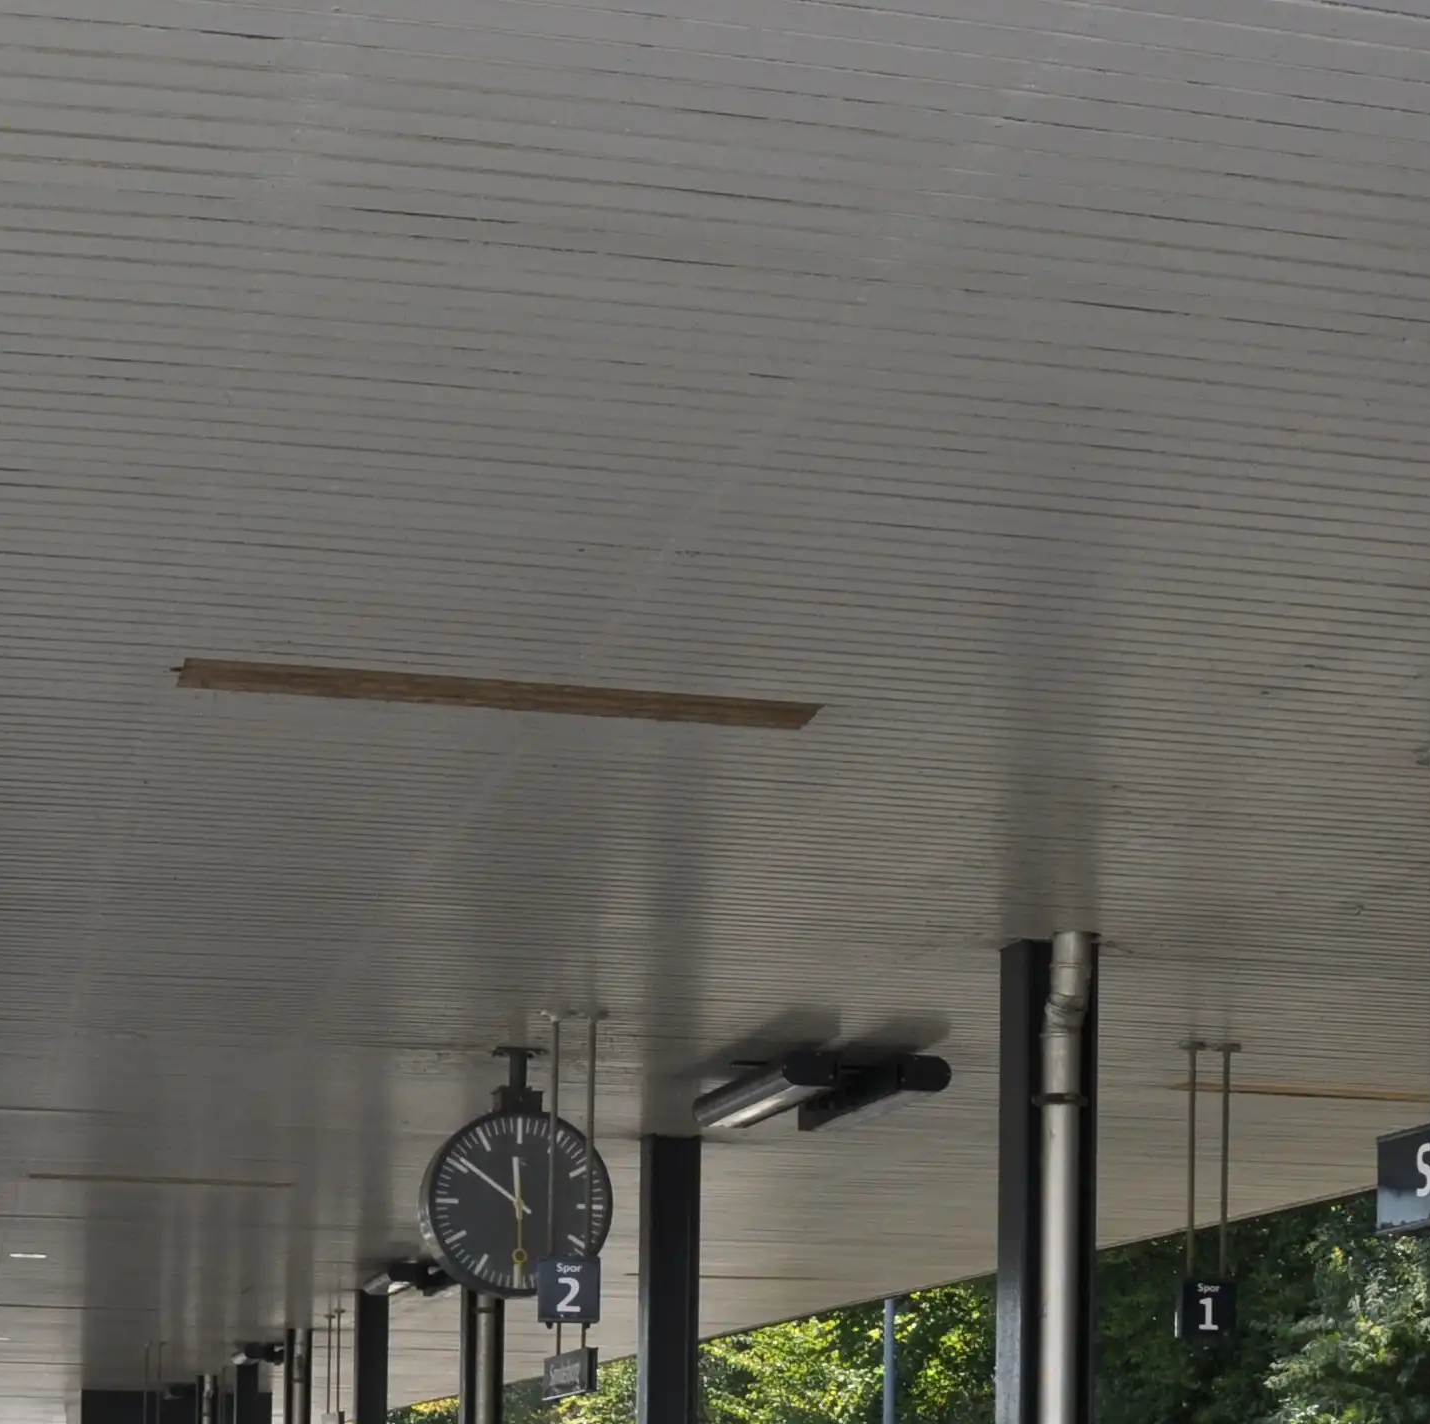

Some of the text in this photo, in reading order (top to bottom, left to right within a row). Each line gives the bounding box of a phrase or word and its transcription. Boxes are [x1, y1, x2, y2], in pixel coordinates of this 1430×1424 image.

[556, 1262, 583, 1275] Spor
[556, 1277, 581, 1312] 2
[1197, 1282, 1220, 1294] Spor
[1198, 1297, 1219, 1330] 1
